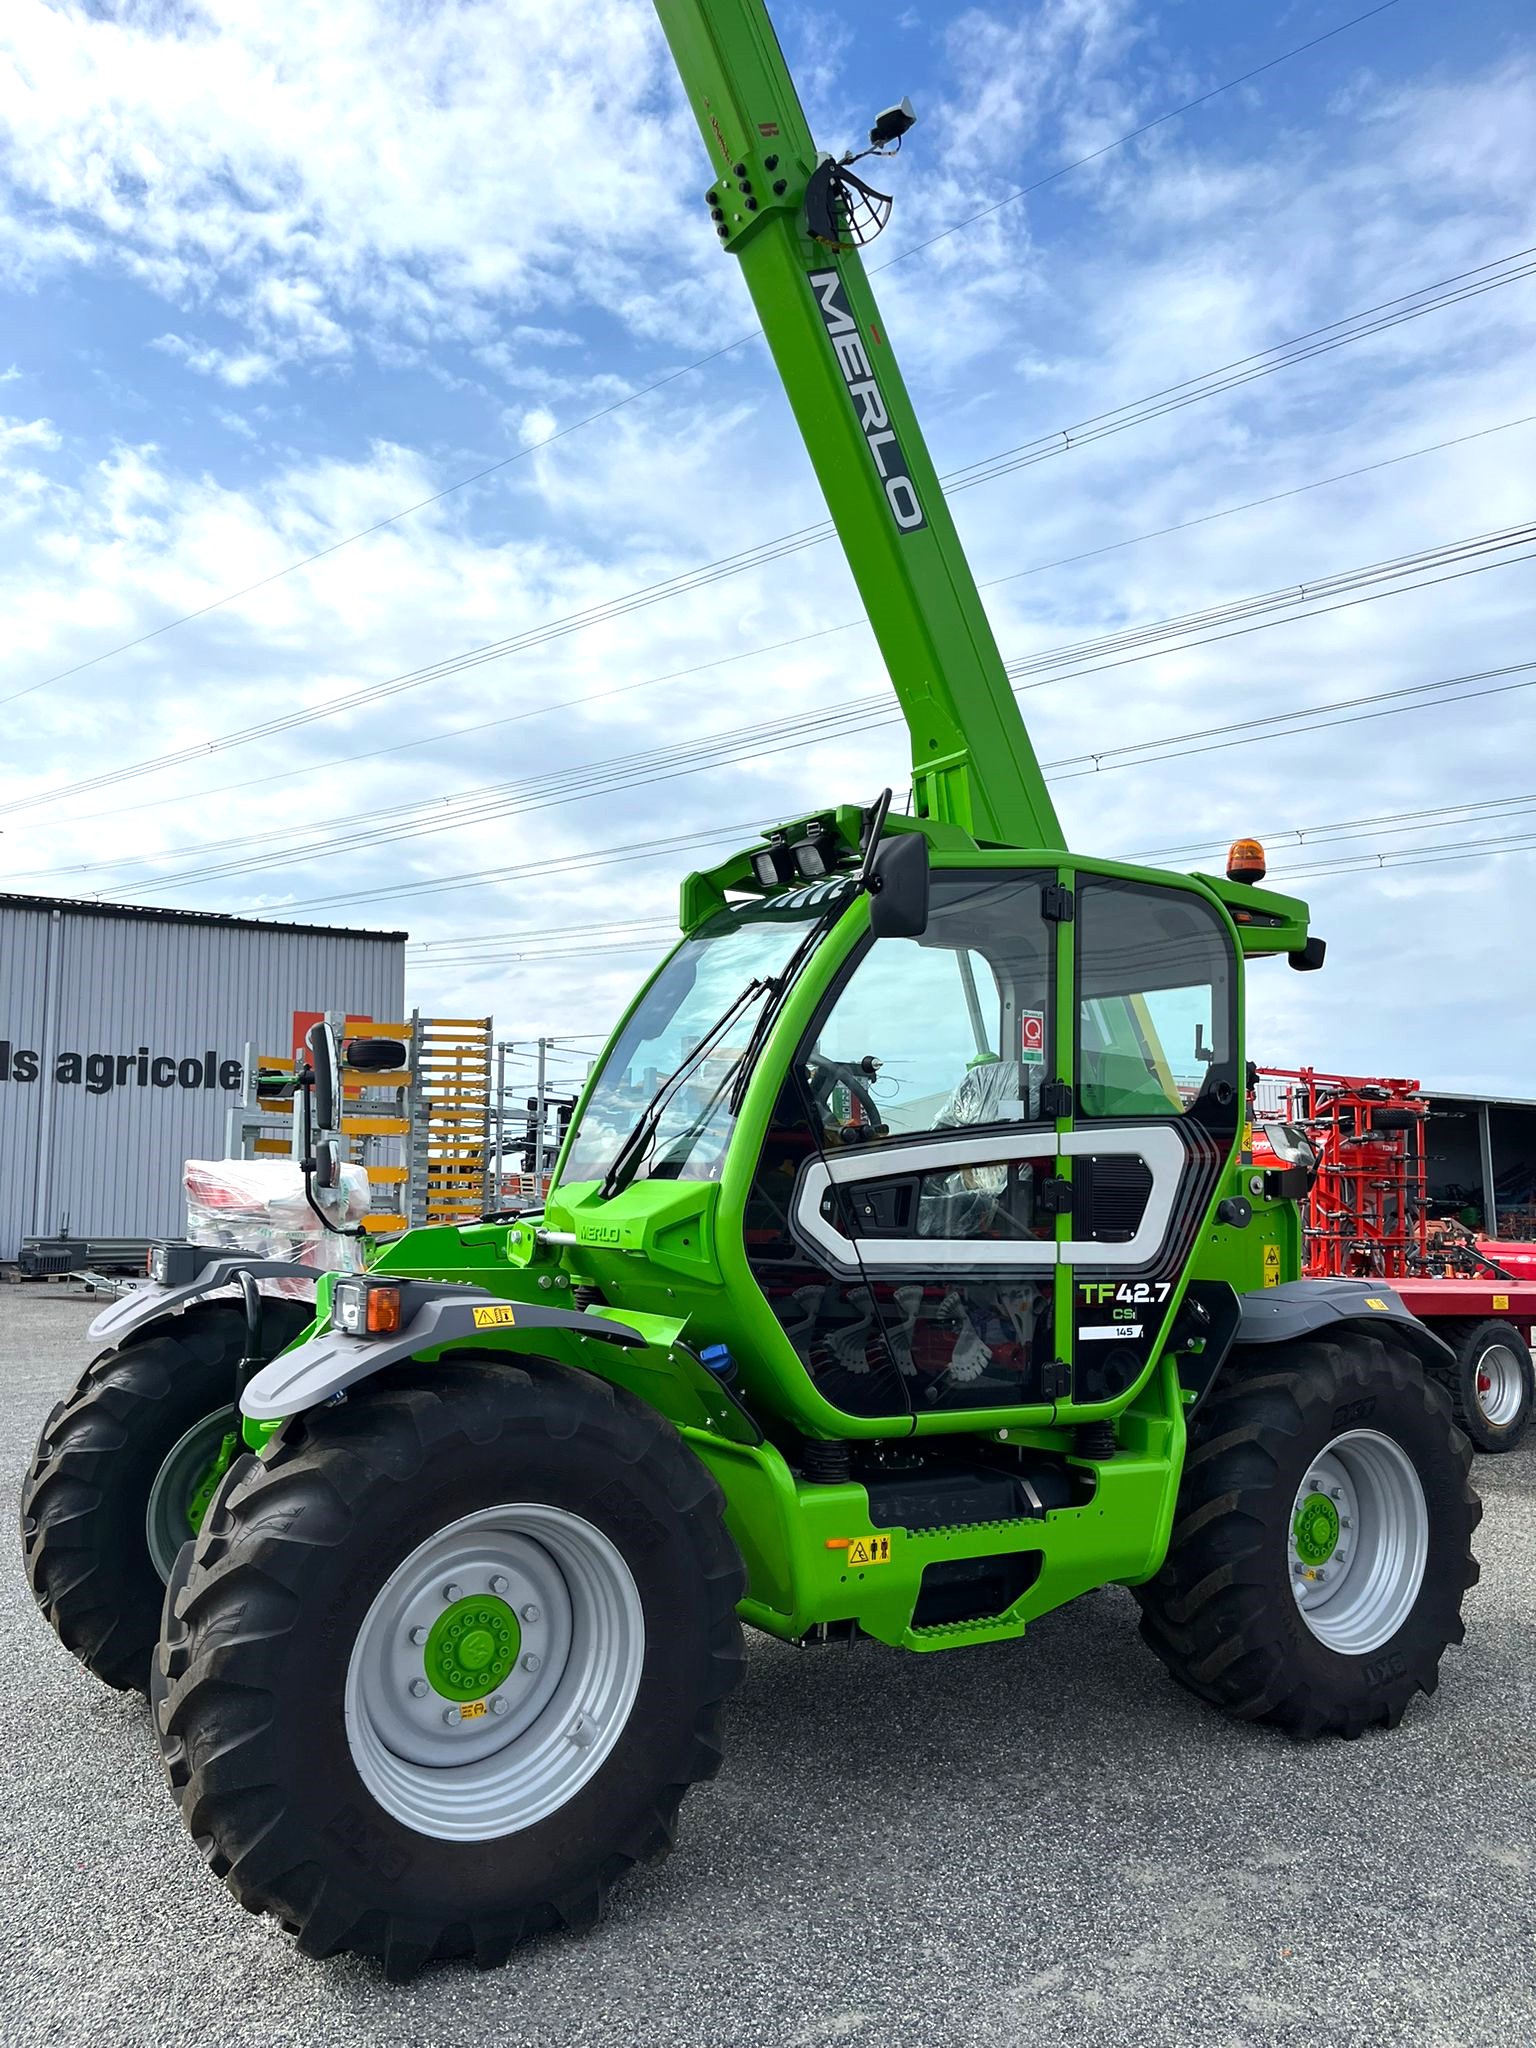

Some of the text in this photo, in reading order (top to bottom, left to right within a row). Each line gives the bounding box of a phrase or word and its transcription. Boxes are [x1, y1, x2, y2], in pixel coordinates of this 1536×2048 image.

[810, 271, 923, 529] MERLO
[56, 1047, 242, 1095] agricole
[580, 1225, 621, 1243] MERLO
[1079, 1282, 1171, 1304] TF42.7
[1116, 1327, 1134, 1337] 145
